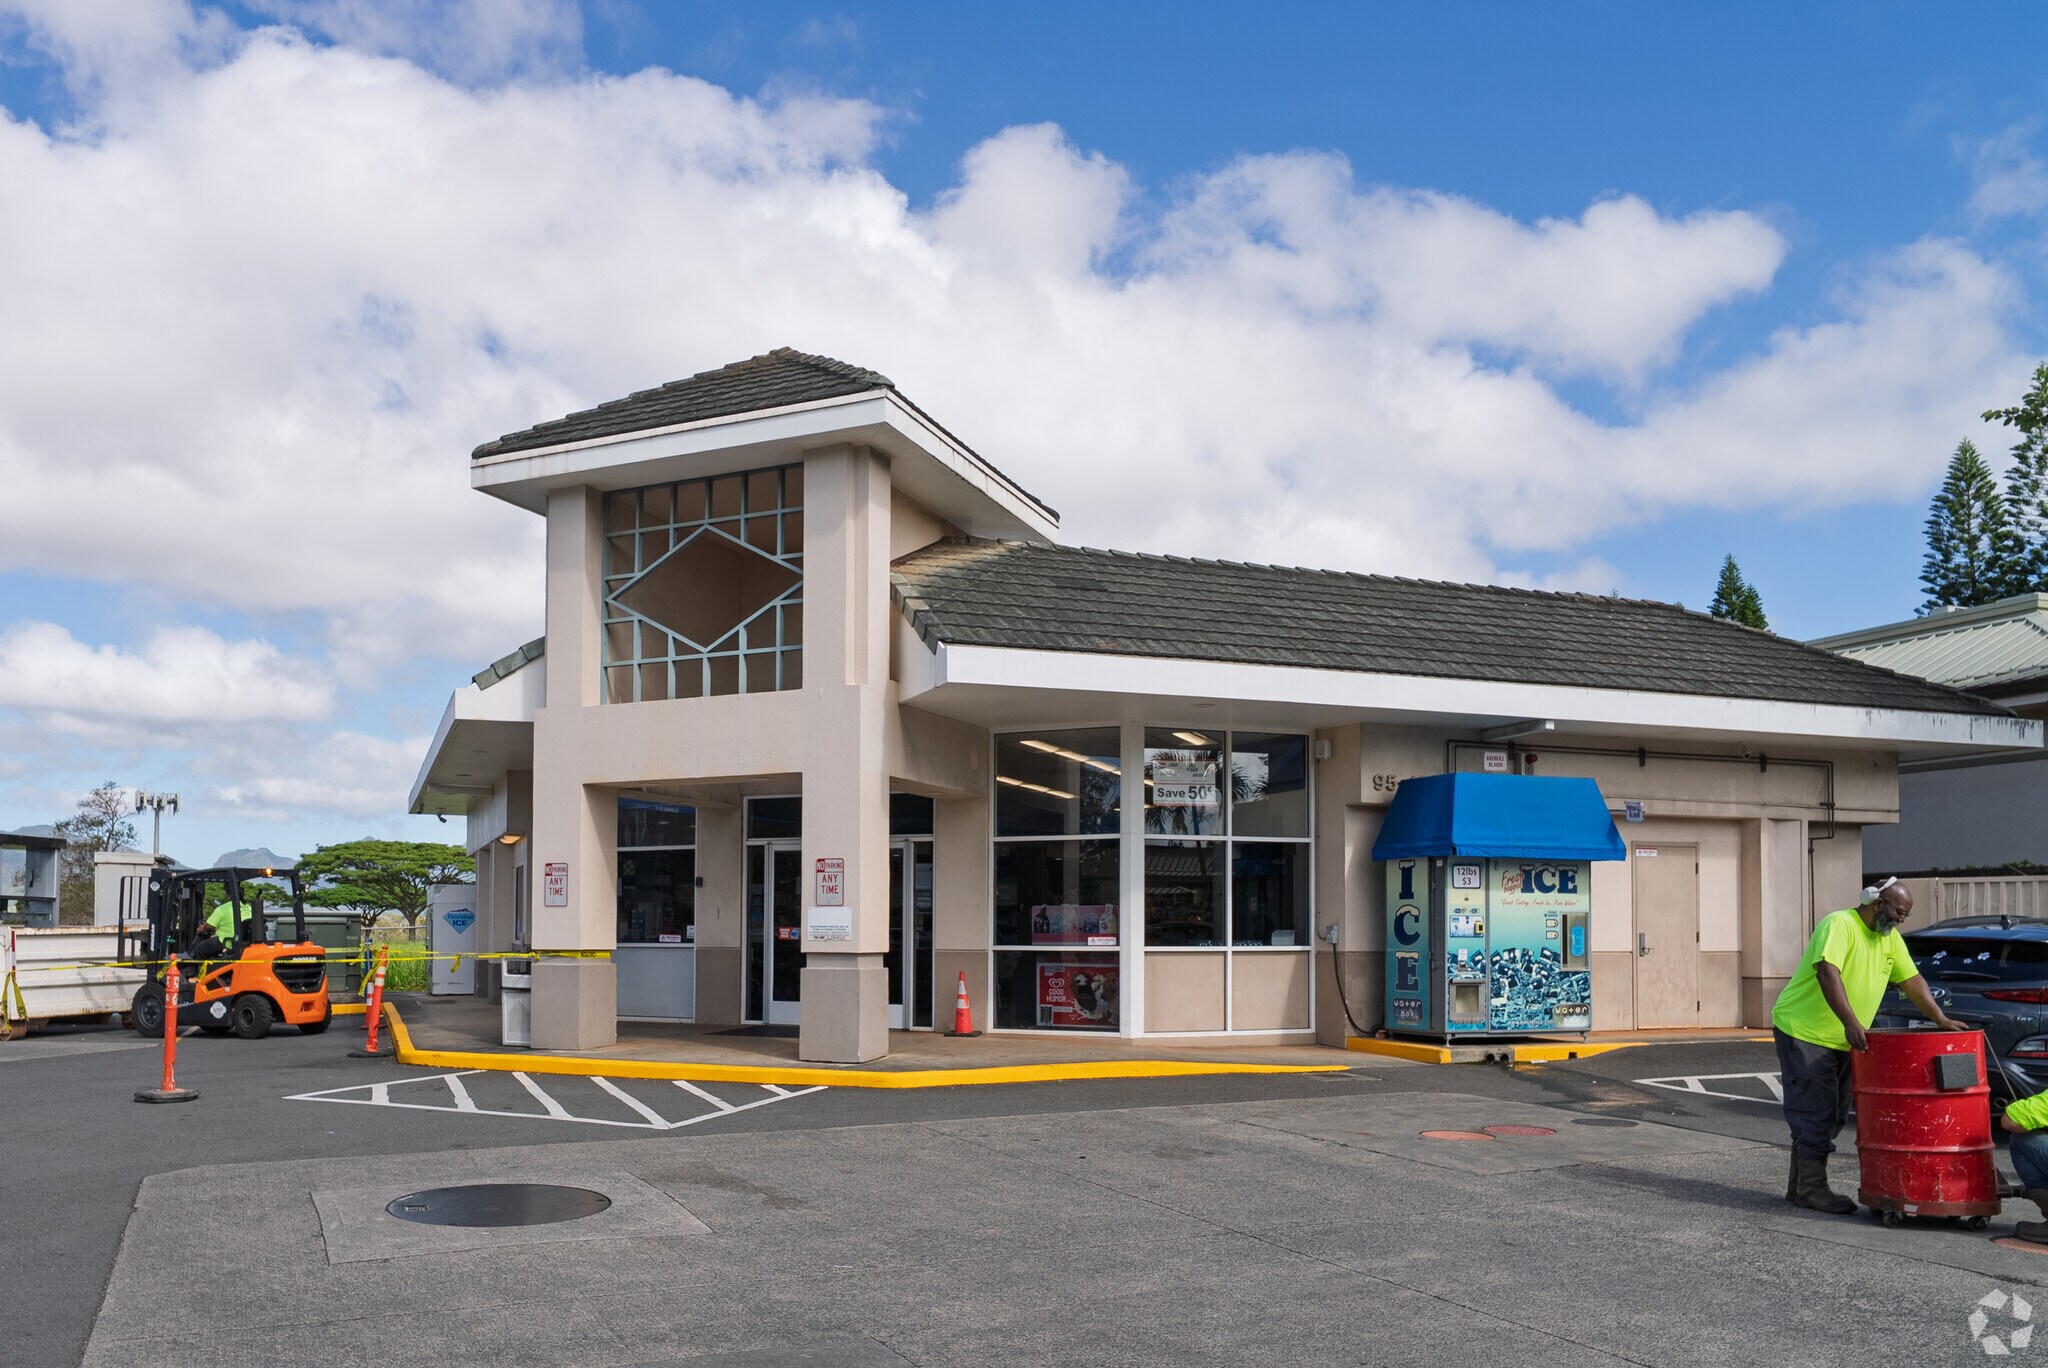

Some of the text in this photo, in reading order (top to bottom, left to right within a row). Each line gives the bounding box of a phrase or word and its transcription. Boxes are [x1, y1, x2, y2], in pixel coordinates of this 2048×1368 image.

[1157, 787, 1186, 798] Save
[816, 860, 825, 871] NO
[1456, 867, 1478, 876] 12lbs
[549, 877, 564, 886] ANY
[821, 874, 839, 884] ANY
[1462, 877, 1472, 886] $3
[1501, 863, 1579, 894] Fresh ICE
[549, 887, 564, 896] TIME
[821, 885, 840, 895] TIME
[1048, 988, 1065, 996] GOOD
[1046, 995, 1067, 1003] HUMOR
[1555, 1007, 1588, 1015] water
